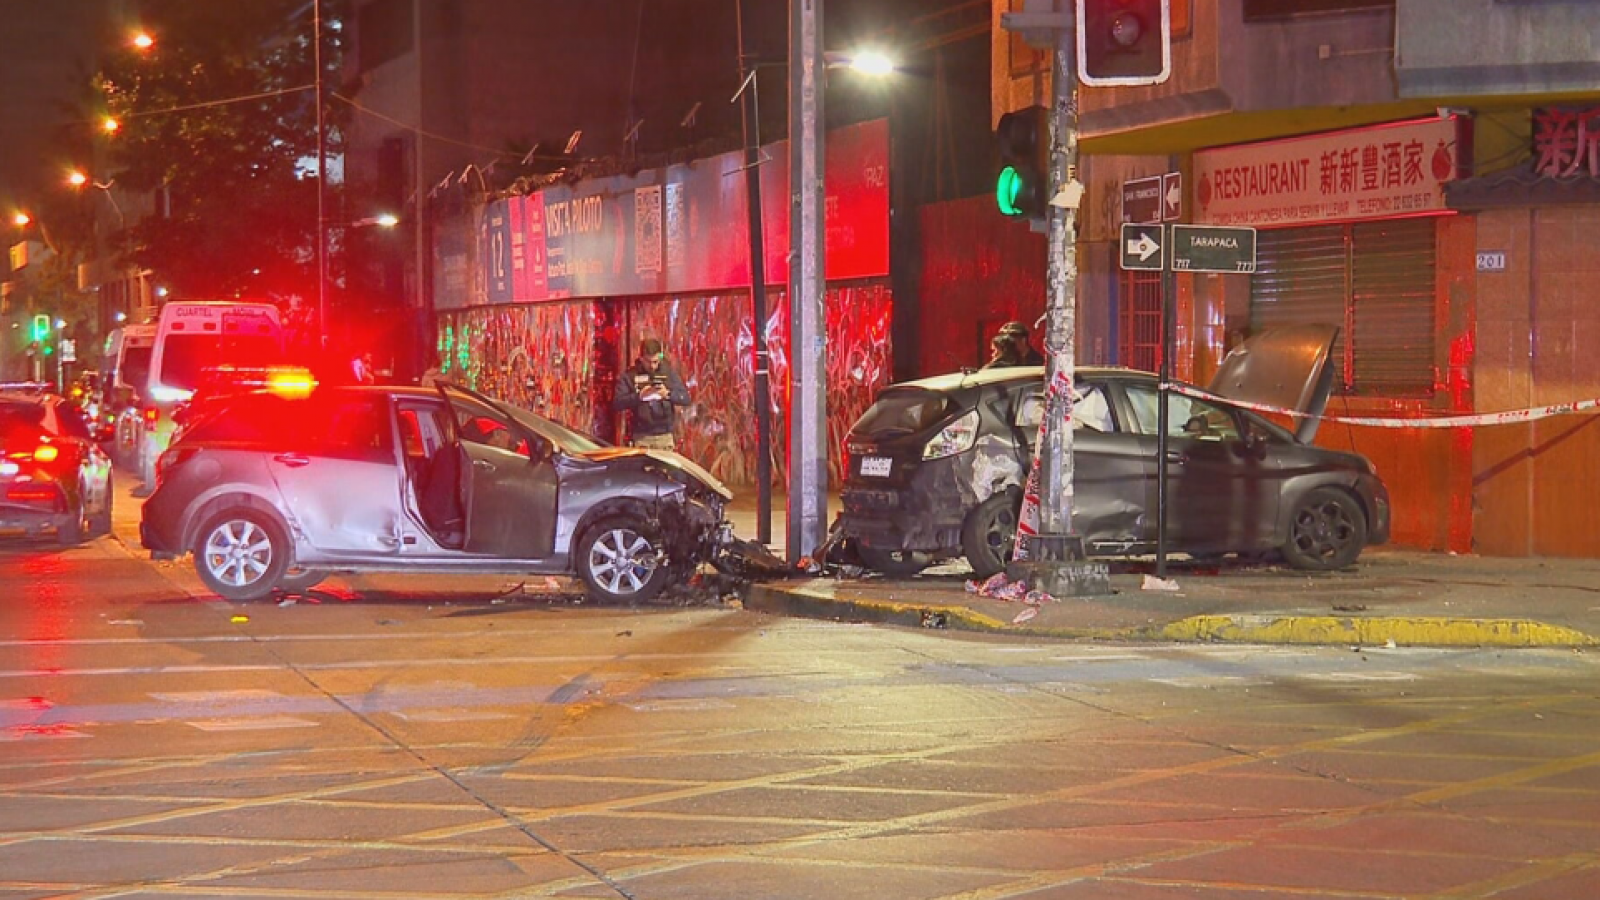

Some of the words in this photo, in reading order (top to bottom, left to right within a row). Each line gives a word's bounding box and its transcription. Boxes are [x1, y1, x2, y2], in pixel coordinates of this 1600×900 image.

[1214, 158, 1310, 200] RESTAURANT
[1319, 138, 1425, 195] 新新豐酒家
[545, 201, 571, 238] VISITA
[573, 195, 602, 233] PILOTO
[1477, 255, 1502, 269] 201
[176, 307, 213, 318] CUARTEL
